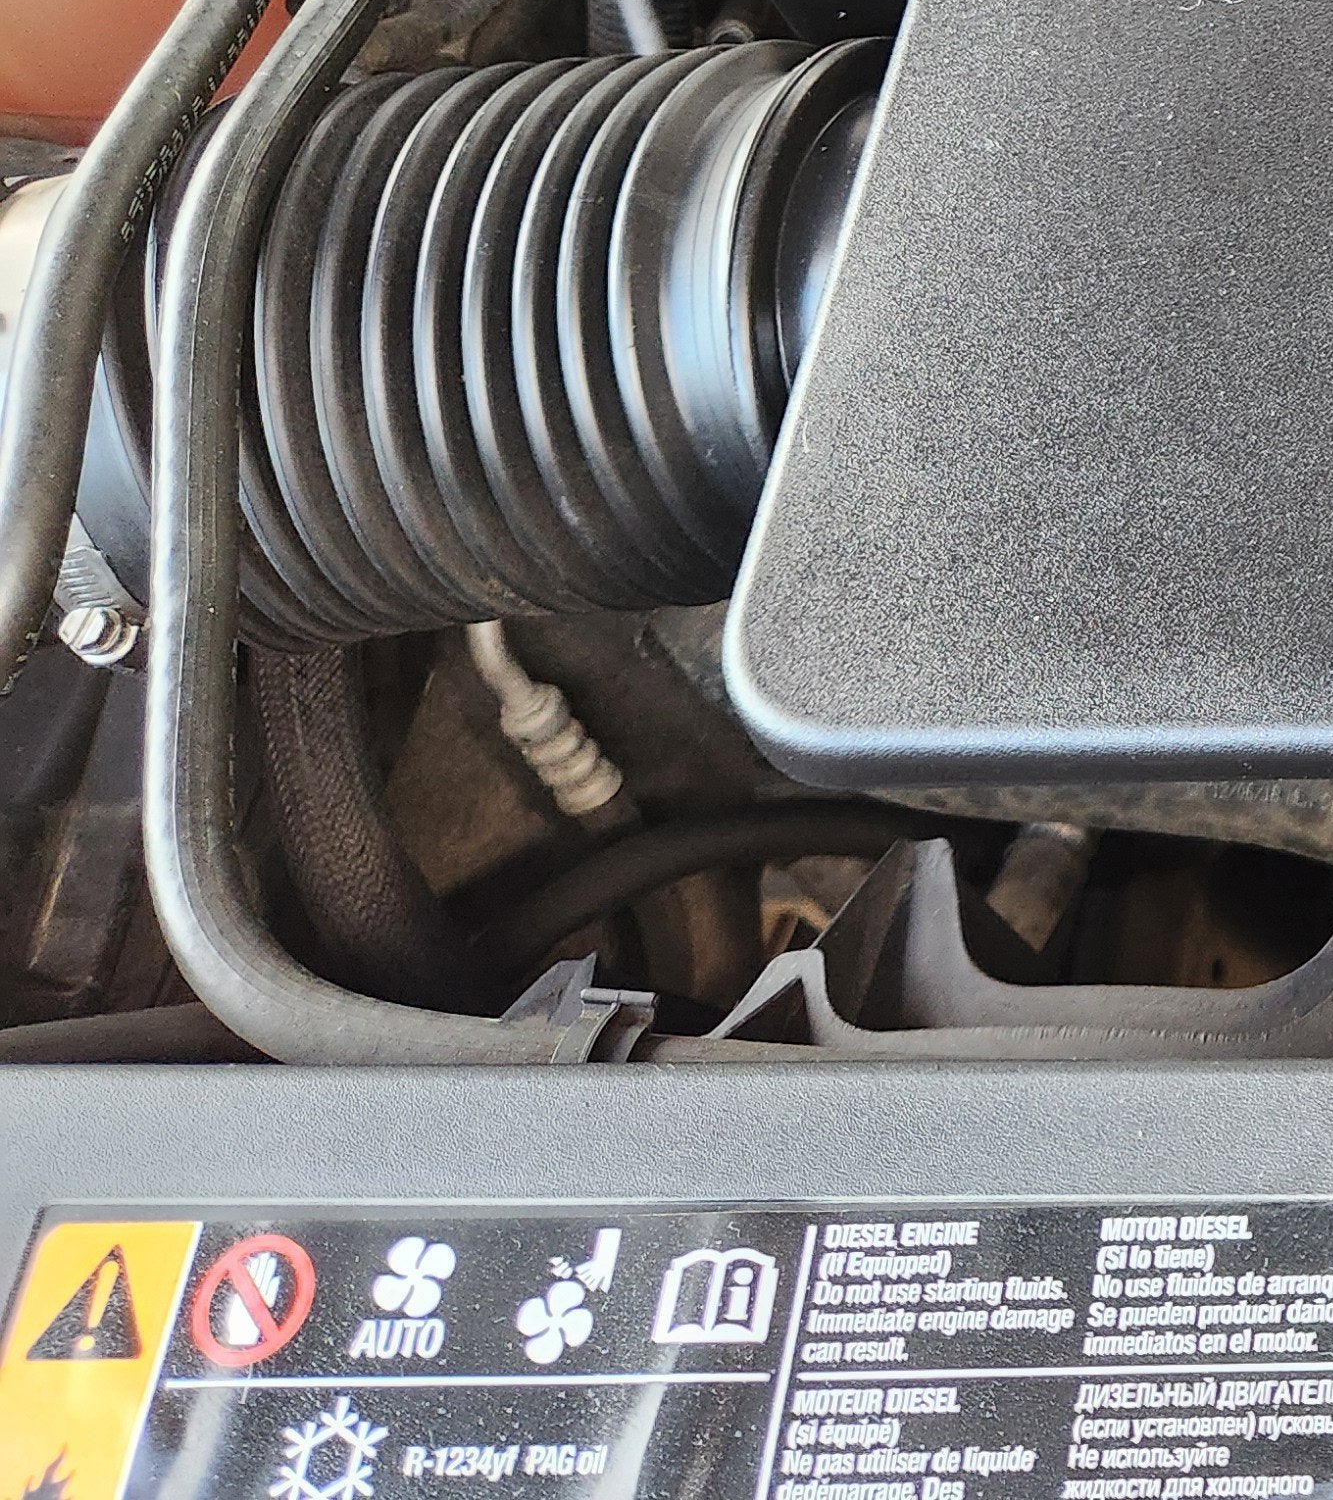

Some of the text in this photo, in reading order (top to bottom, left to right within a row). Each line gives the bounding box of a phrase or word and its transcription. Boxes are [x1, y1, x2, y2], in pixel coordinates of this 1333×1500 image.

[823, 1221, 980, 1248] DIESEL ENGINE
[1100, 1215, 1252, 1241] MOTOR DIESEL
[845, 1250, 951, 1280] Equipped)
[1096, 1244, 1215, 1273] (Si lo tiene)
[814, 1275, 1068, 1306] Do not use starting fluids.
[1092, 1274, 1123, 1298] No
[1125, 1276, 1164, 1297] use
[1166, 1272, 1235, 1297] fluidos
[1237, 1271, 1266, 1296] de
[806, 1306, 1075, 1336] Immediate engine damage
[1087, 1302, 1117, 1328] Se
[1118, 1302, 1196, 1331] pueden
[1198, 1300, 1285, 1329] producir
[349, 1318, 445, 1359] AUTO
[802, 1337, 909, 1362] can result.
[1083, 1329, 1318, 1356] inmediatos en el motor.
[791, 1387, 961, 1416] MOTEUR DIESEL
[1074, 1377, 1218, 1413] ДИЗЕЛЬНЫЙ
[787, 1418, 900, 1449] (si équipé)
[1072, 1414, 1130, 1443] (если
[1131, 1411, 1257, 1444] установлен)
[403, 1444, 608, 1482] R-1234yf PAG oil
[781, 1445, 1037, 1478] Ne pas utiliser de liquide
[1067, 1442, 1230, 1473] Не используйте
[921, 1476, 966, 1500] Des
[1062, 1475, 1315, 1500] жидкости для холодного
